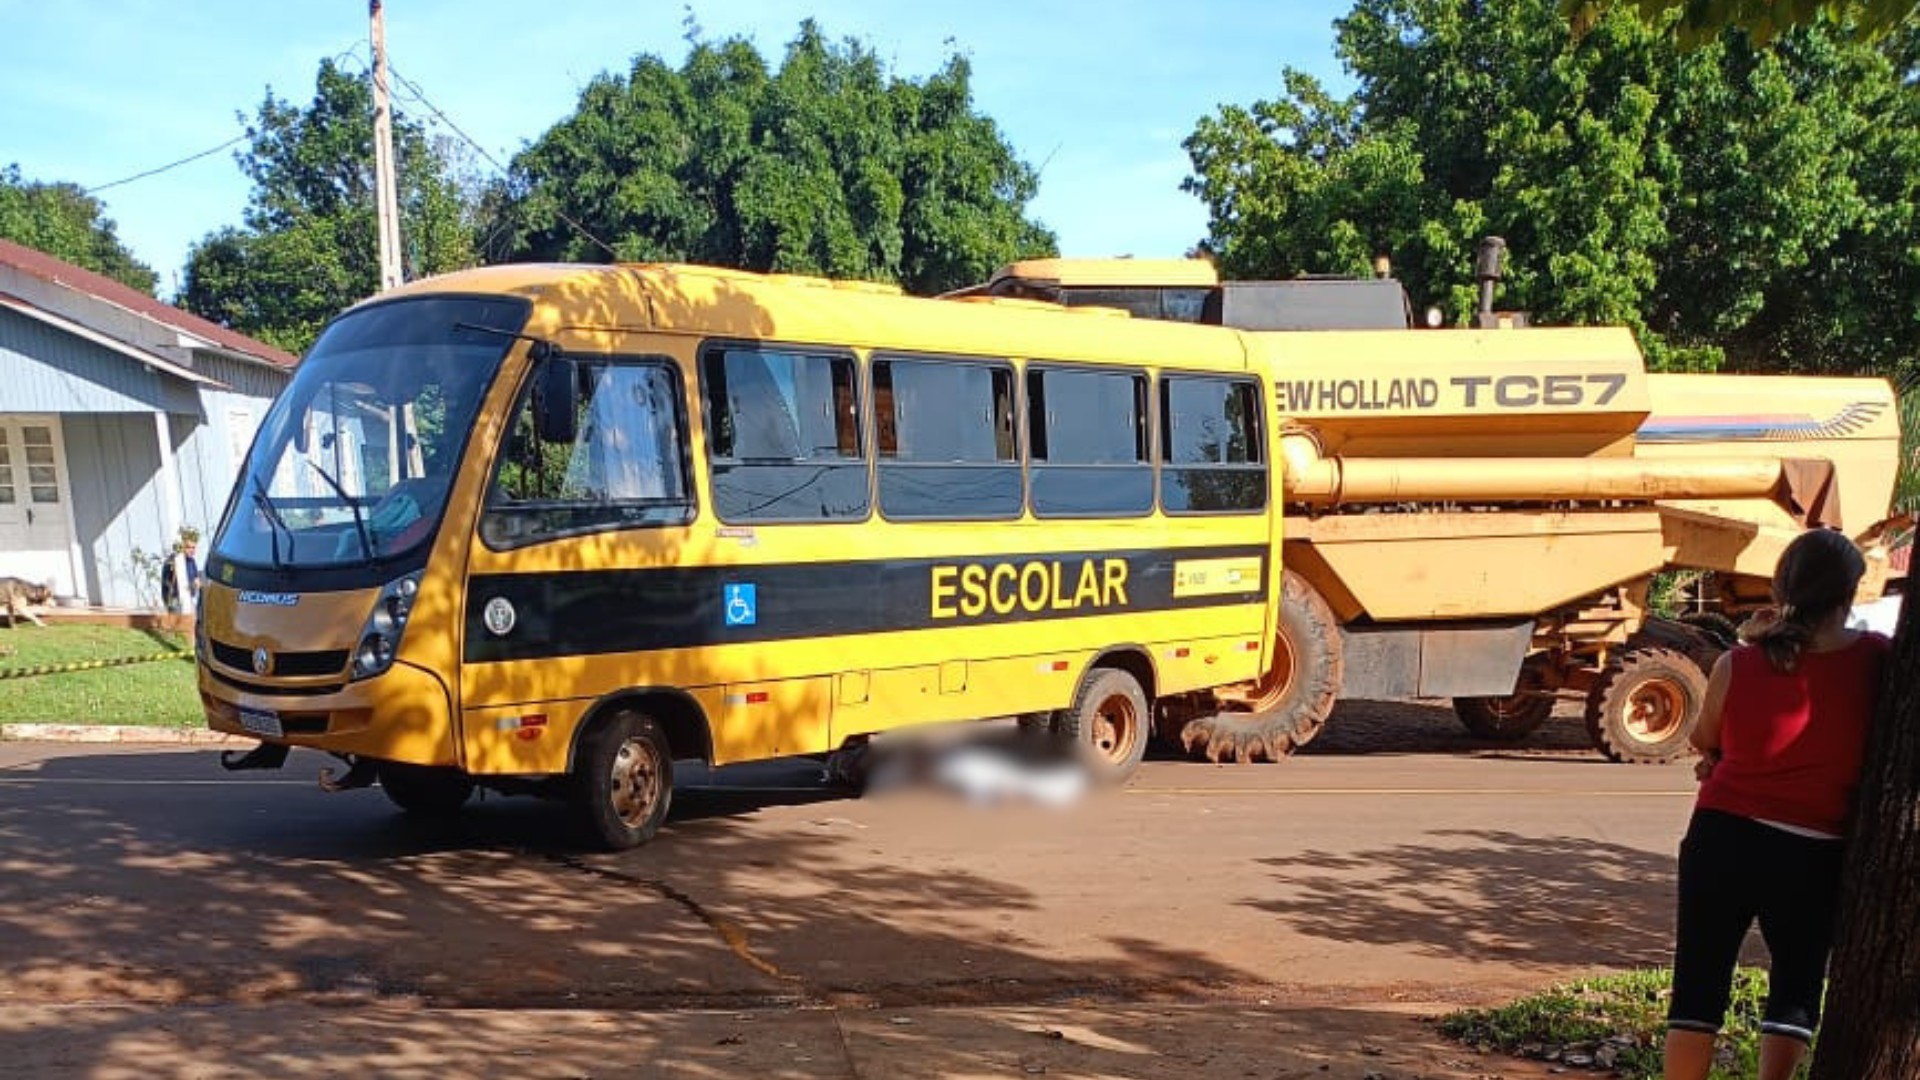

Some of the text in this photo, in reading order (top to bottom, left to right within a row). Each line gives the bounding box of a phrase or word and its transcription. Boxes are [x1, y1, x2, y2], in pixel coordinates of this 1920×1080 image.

[1275, 373, 1627, 411] EW HOLLAND TC57
[931, 558, 1128, 618] ESCOLAR
